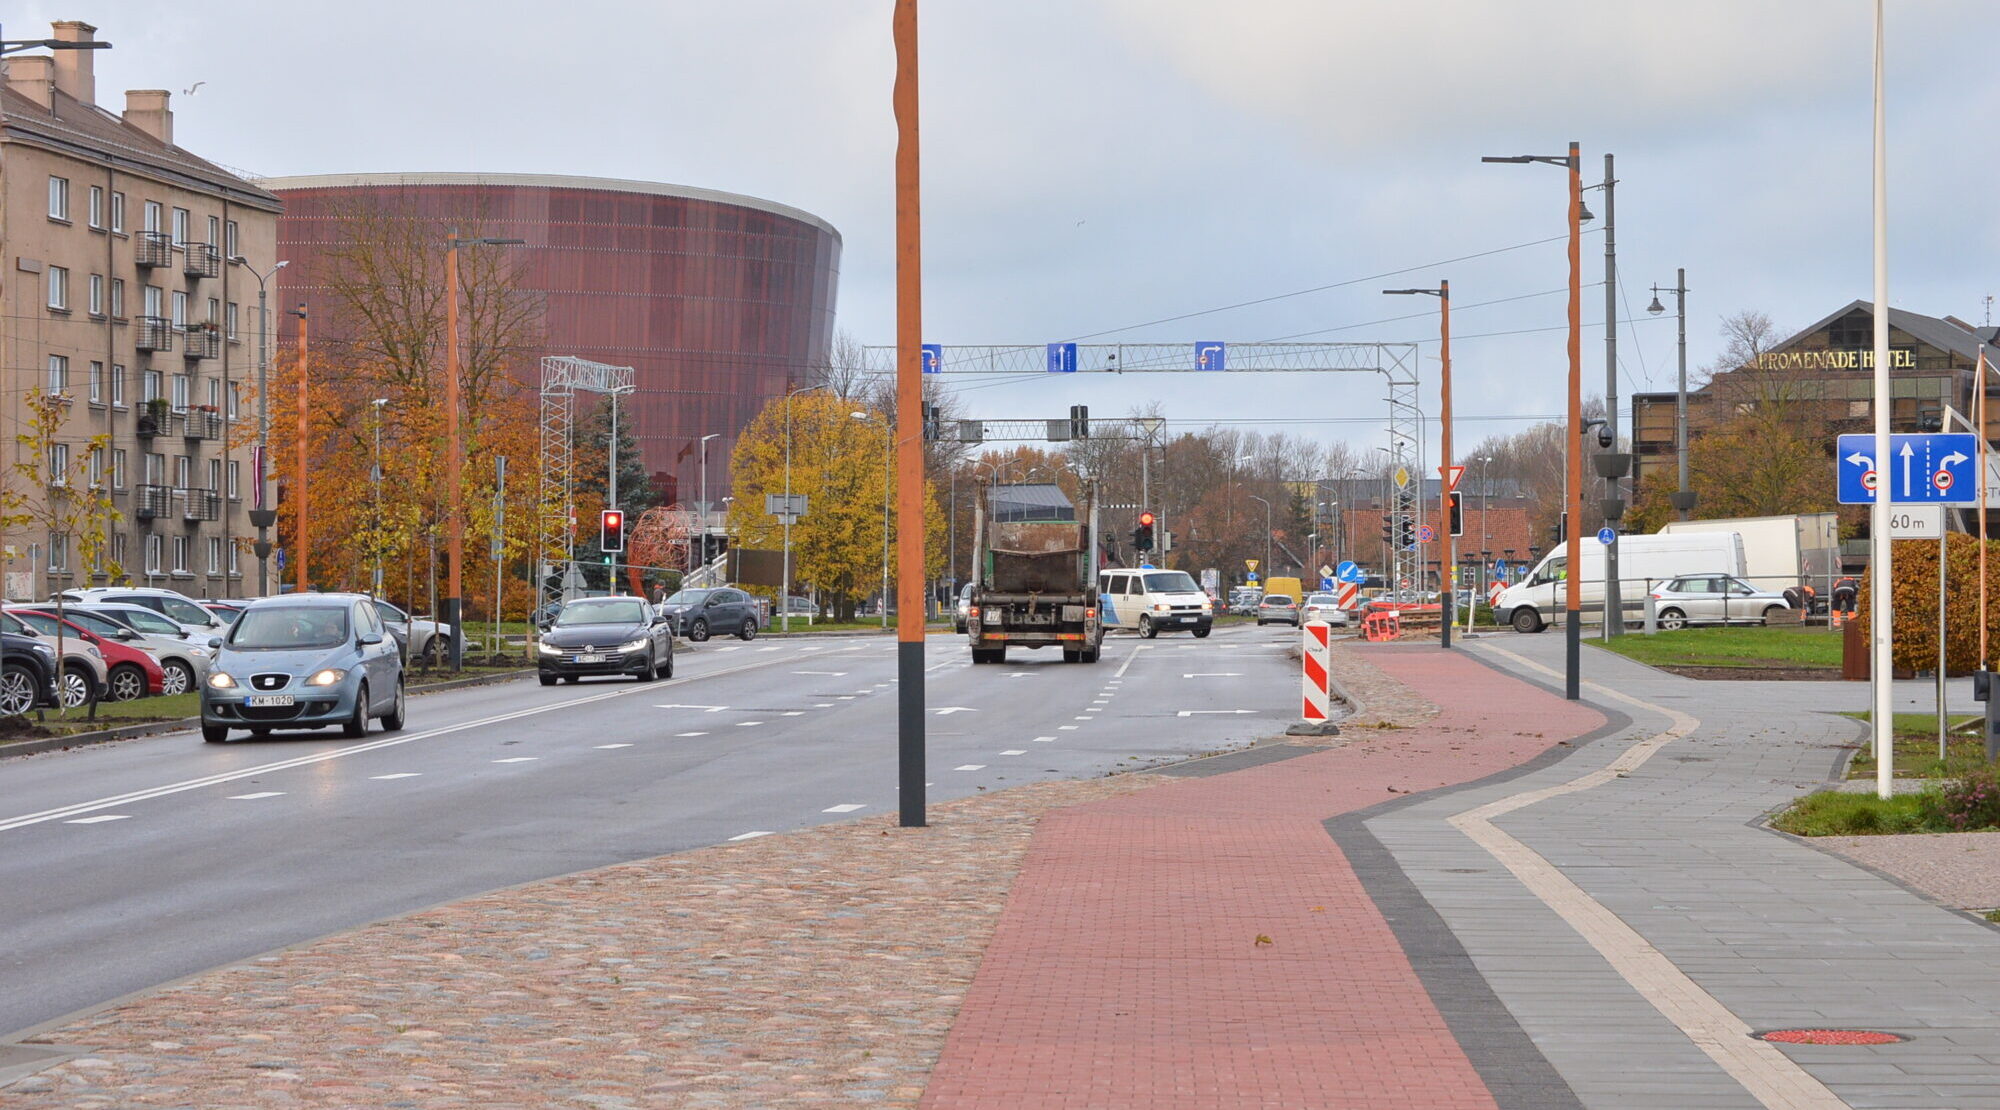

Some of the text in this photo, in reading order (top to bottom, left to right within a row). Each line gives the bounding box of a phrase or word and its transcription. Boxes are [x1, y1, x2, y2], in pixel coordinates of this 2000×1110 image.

[1758, 350, 1915, 370] PROMENADE HTEL
[1890, 514, 1925, 529] 60 m
[252, 696, 293, 705] KM-1020
